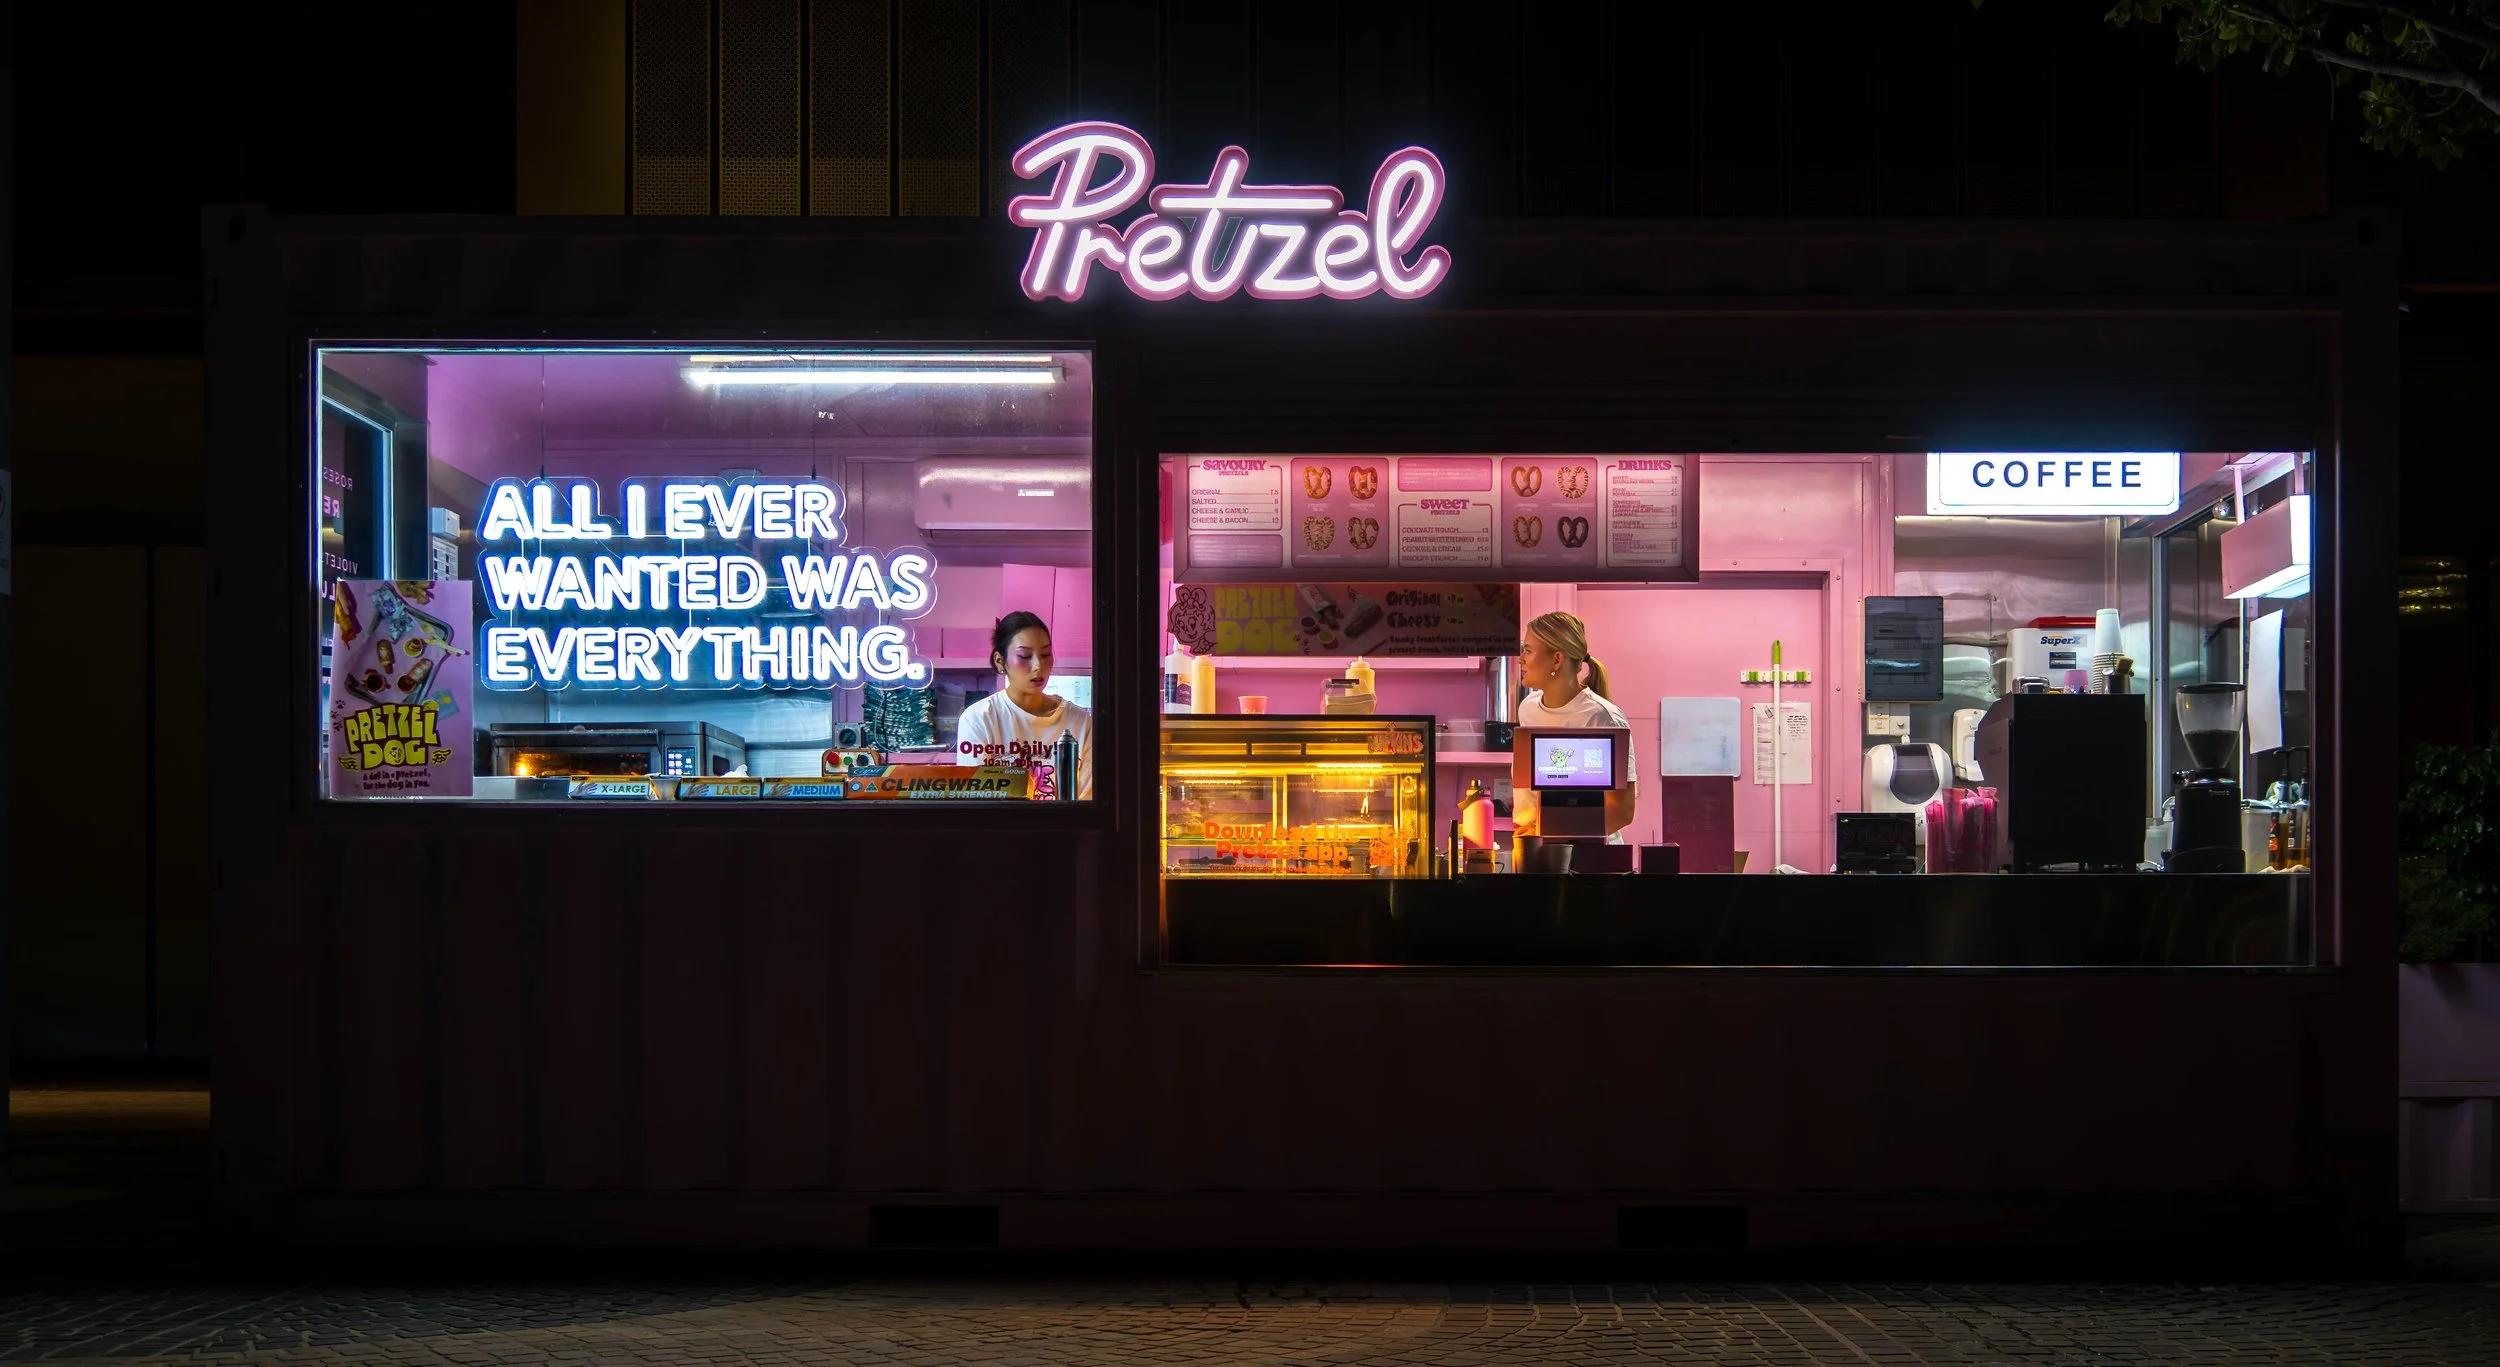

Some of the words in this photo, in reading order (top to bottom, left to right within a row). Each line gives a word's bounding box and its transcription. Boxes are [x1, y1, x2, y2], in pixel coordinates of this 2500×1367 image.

[1010, 122, 1450, 300] Pretzel
[1972, 460, 2142, 488] COFFEE
[482, 484, 612, 540] ALL
[626, 484, 646, 540] I
[664, 484, 839, 540] EVER
[484, 554, 768, 611] WANTED
[783, 554, 929, 611] WAS
[1386, 588, 1441, 607] Original
[1386, 612, 1441, 628] Cheesy
[1215, 619, 1300, 653] DOG
[2040, 635, 2081, 646] SuperX
[487, 625, 926, 682] EVERYTHING.
[345, 704, 439, 752] PRETZEL
[363, 739, 426, 769] DOG
[959, 740, 1005, 758] Open
[1009, 740, 1058, 759] Daily!
[387, 780, 404, 790] dog
[600, 785, 646, 794] X-LARGE
[715, 785, 758, 796] LARGE
[792, 785, 841, 796] MEDIUM
[881, 778, 1011, 792] CLINGWRAP
[910, 791, 945, 799] EXTRA
[948, 791, 1008, 799] STRENGTH
[1204, 821, 1318, 841] Download
[1216, 841, 1300, 860] Pretzel
[1303, 845, 1350, 866] app
